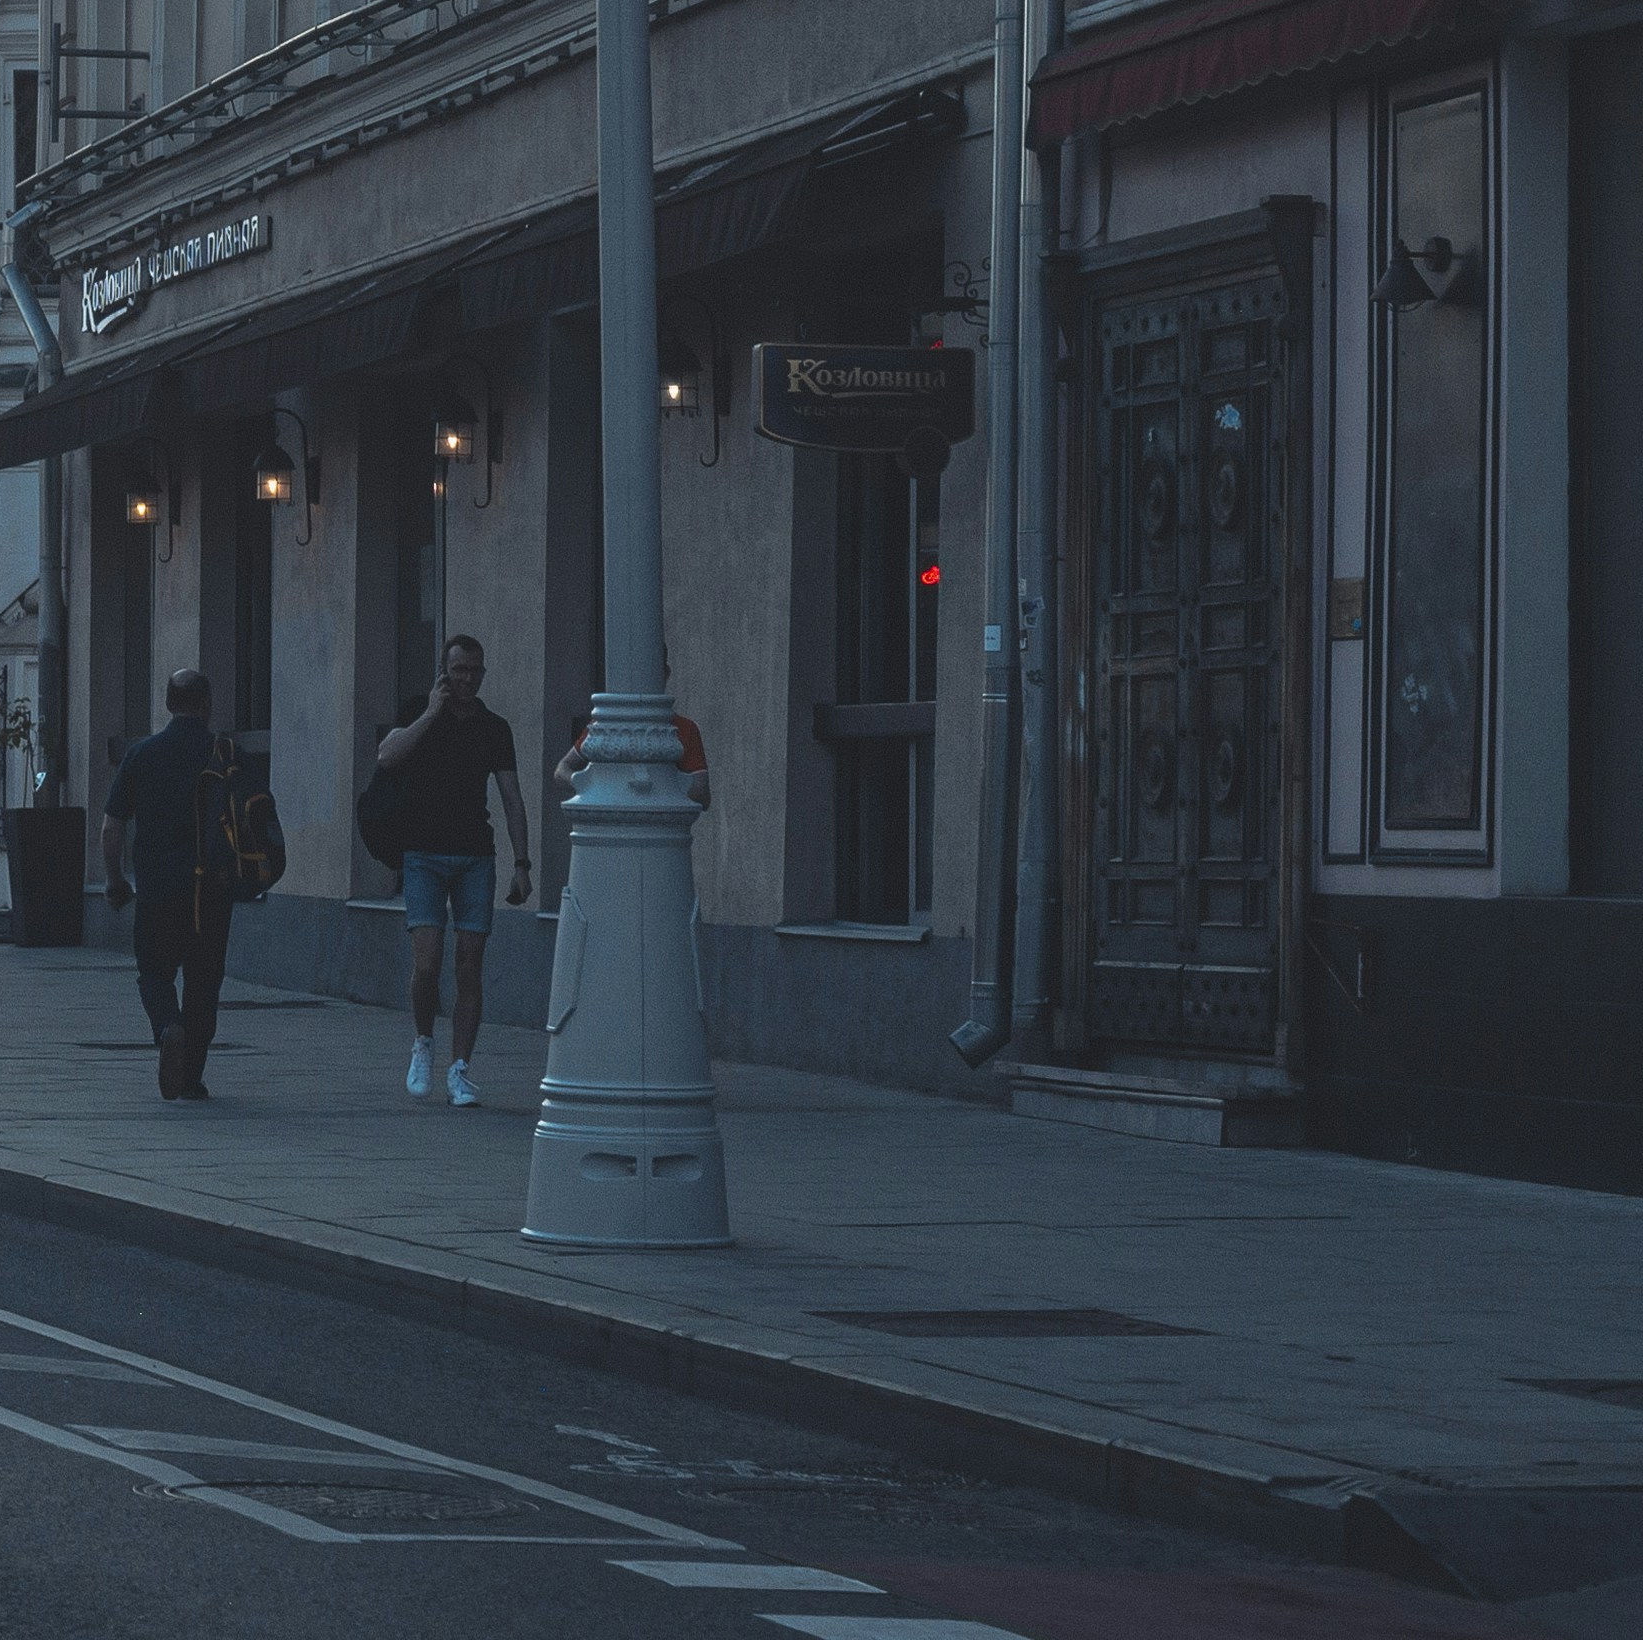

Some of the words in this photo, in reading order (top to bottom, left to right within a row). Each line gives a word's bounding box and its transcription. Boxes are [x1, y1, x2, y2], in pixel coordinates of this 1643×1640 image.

[81, 256, 141, 333] Козловица
[148, 236, 202, 285] ЧЕШСКАЯ
[207, 214, 259, 265] ПИВНАЯ
[786, 358, 946, 396] Козловица
